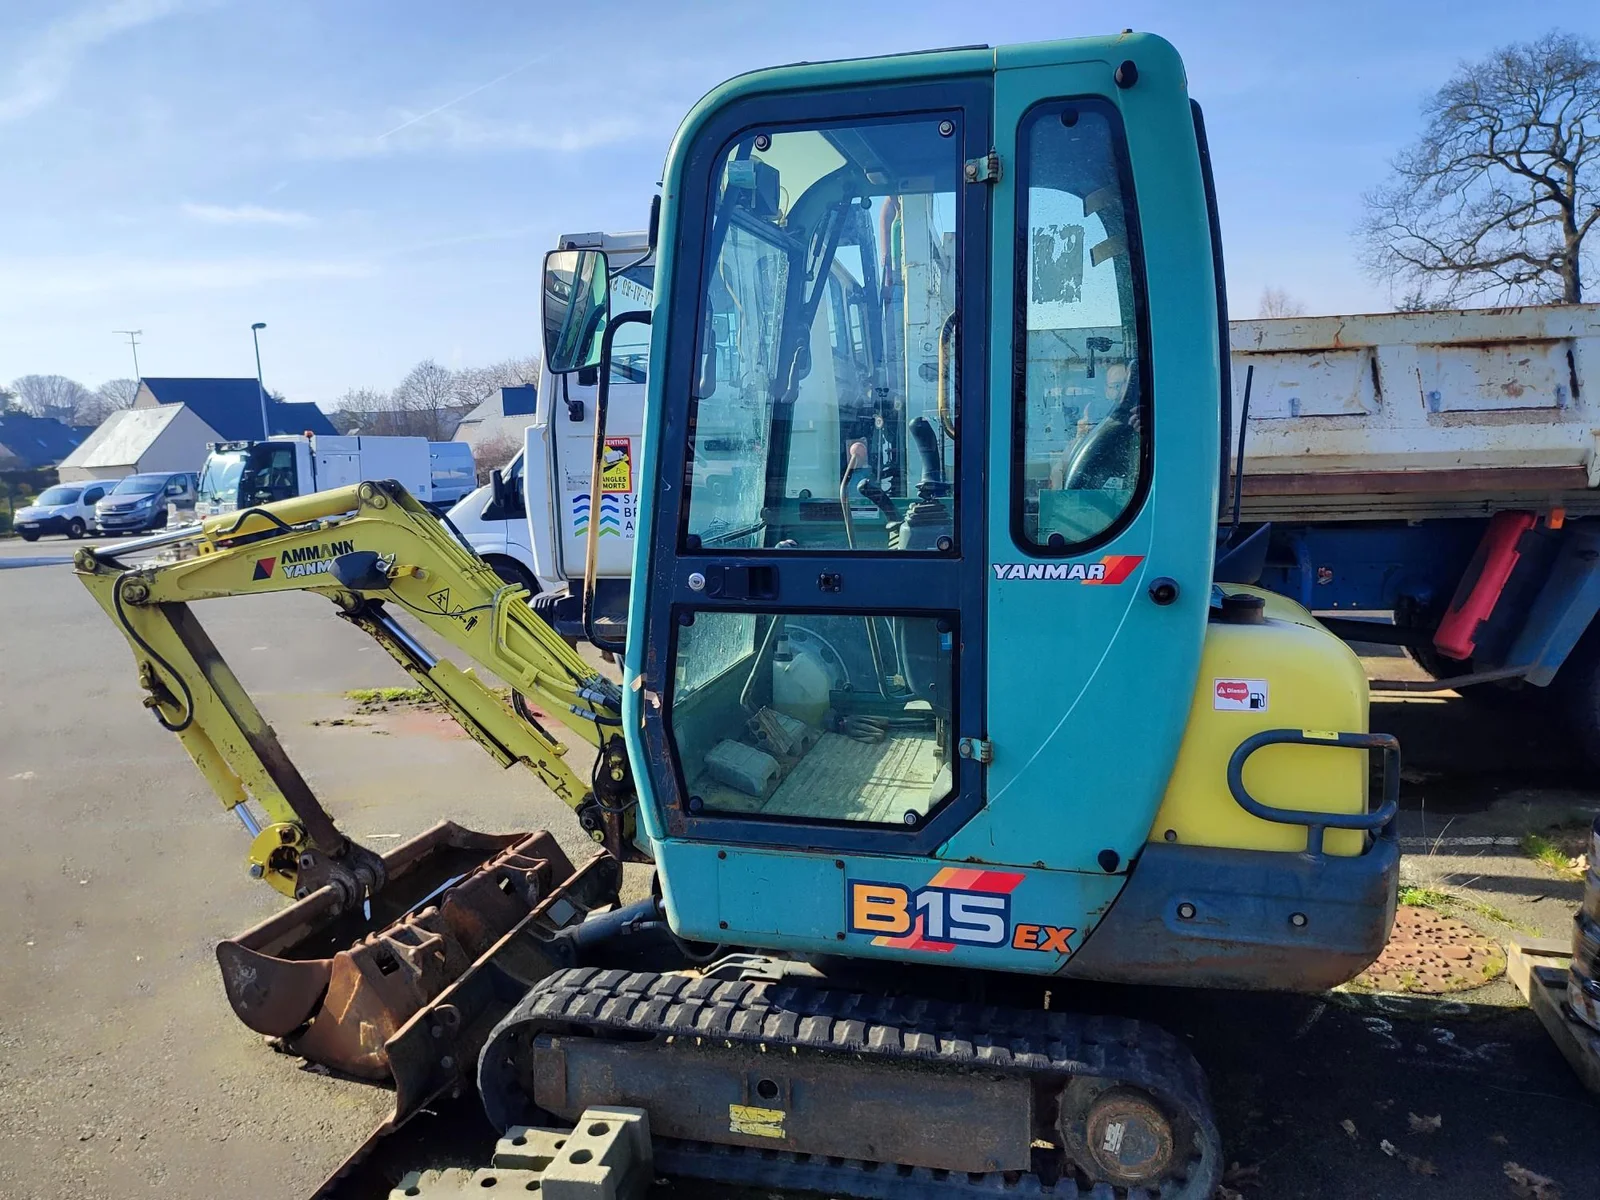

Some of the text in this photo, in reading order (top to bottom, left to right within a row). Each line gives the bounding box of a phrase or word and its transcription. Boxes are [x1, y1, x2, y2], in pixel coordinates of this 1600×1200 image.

[281, 539, 355, 565] AMMANN
[993, 563, 1106, 581] YANMAR
[851, 881, 1077, 954] B15 EX
